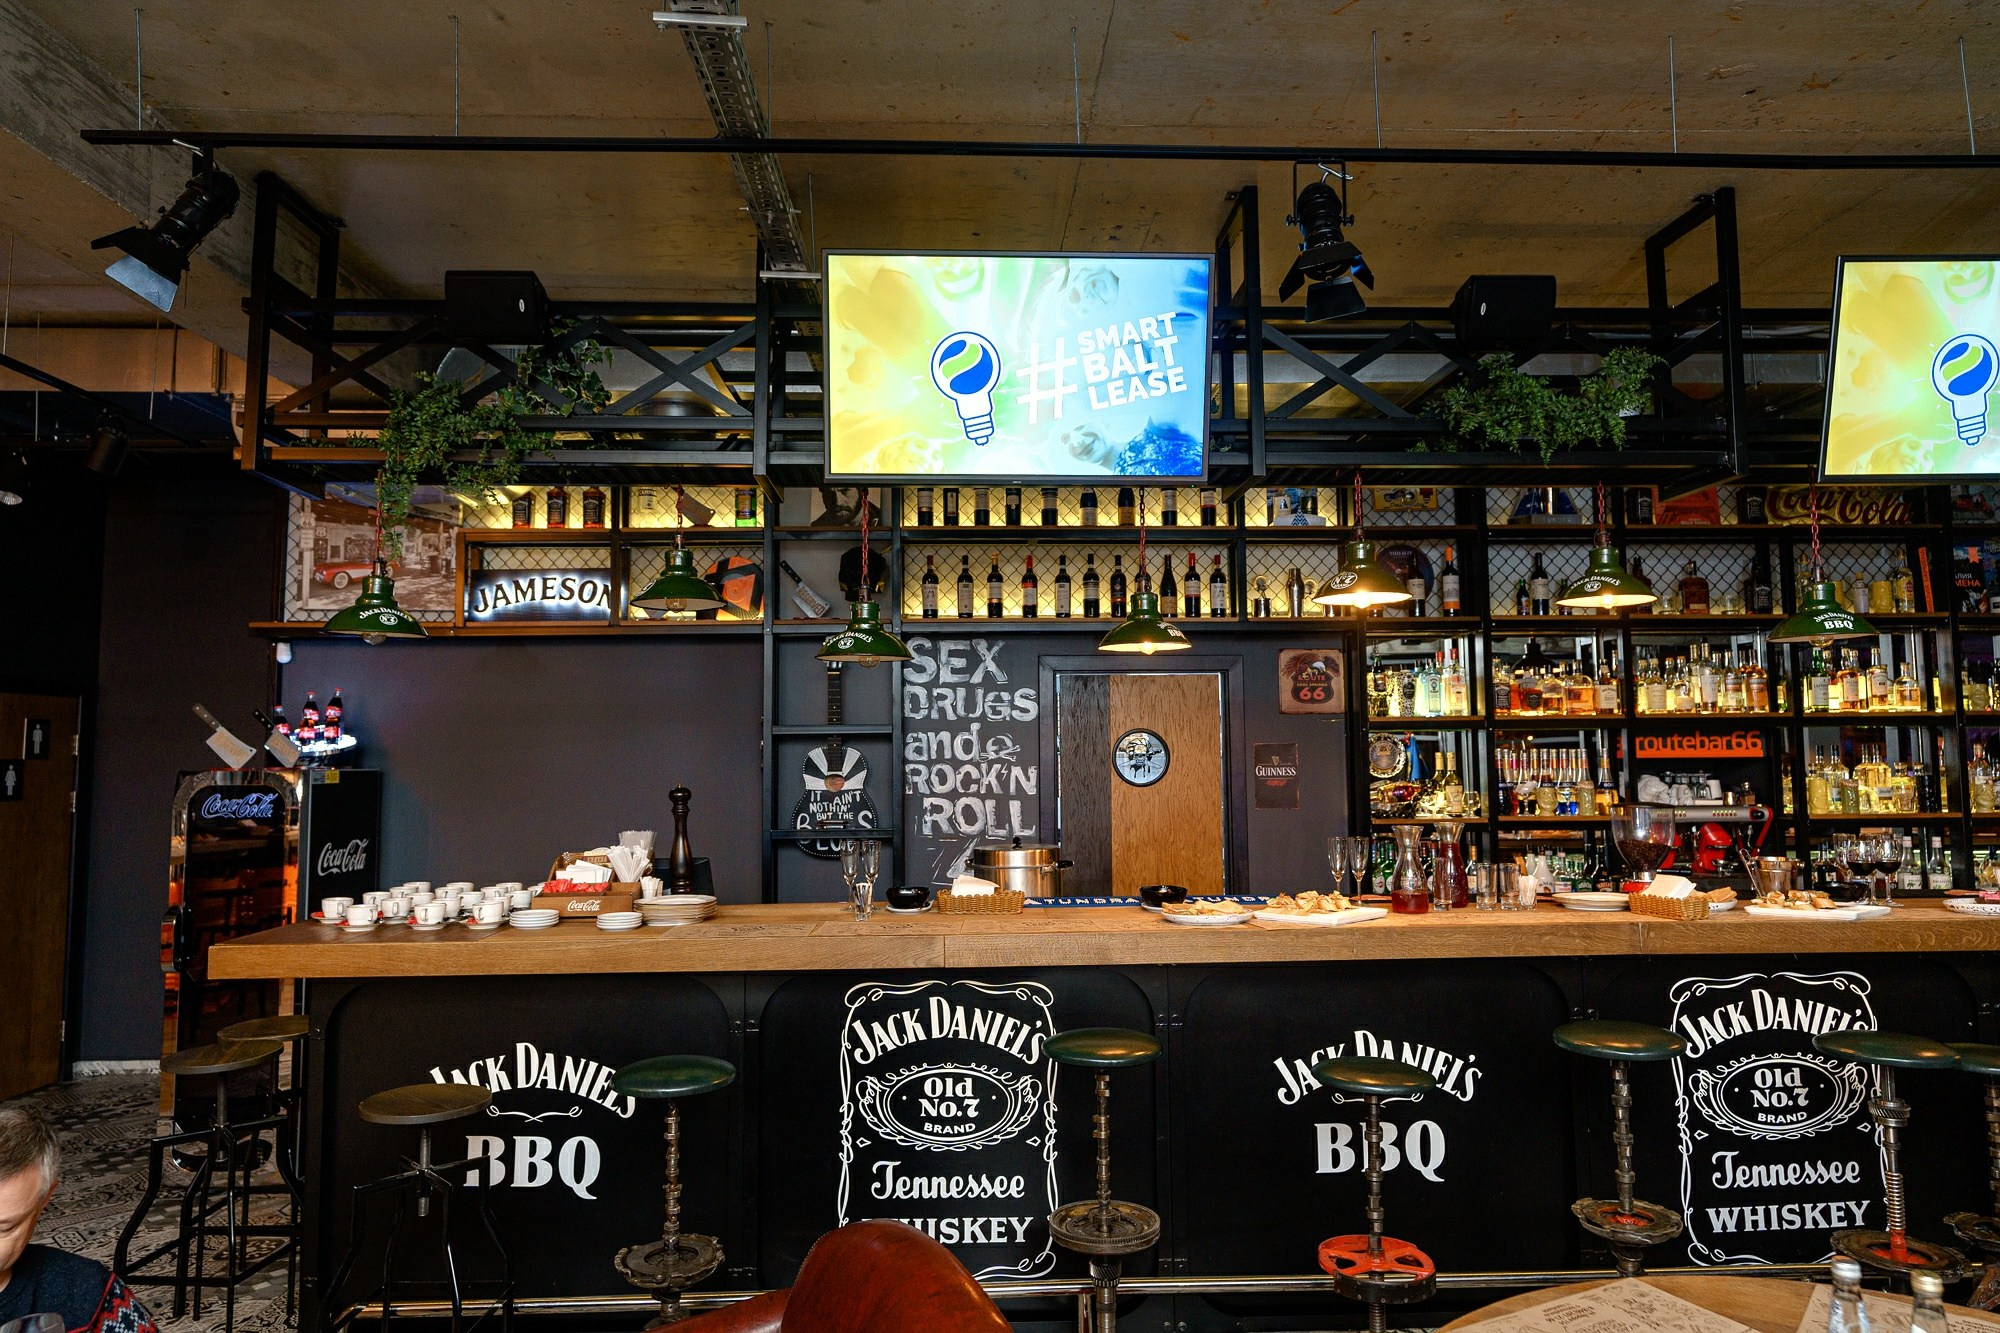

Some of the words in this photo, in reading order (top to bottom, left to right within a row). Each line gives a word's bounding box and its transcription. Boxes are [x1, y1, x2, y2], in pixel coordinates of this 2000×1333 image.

[1077, 312, 1177, 355] SMART
[1081, 336, 1179, 385] BALT
[1087, 367, 1188, 411] LEASE
[1823, 620, 1854, 630] BBQ
[903, 636, 1009, 685] SEX
[903, 683, 1039, 722] DRUGS
[1299, 686, 1326, 701] 66
[904, 722, 982, 763] and
[1635, 730, 1762, 752] routebar66
[1255, 765, 1297, 777] GUINNESS
[202, 793, 279, 819] Coca-Cola
[809, 801, 851, 814] NOTHIN'
[811, 790, 822, 802] IT
[833, 790, 861, 806] AIN'T
[816, 812, 833, 820] BUT
[838, 812, 854, 820] THE
[921, 796, 1036, 838] ROLL
[317, 838, 369, 877] Coca-Cola
[567, 900, 602, 912] Coca-Cola
[852, 1007, 928, 1065] JACK
[928, 996, 1048, 1065] DANIEL'S
[1679, 1001, 1753, 1059] JACK
[923, 1077, 975, 1098] Old
[1754, 1067, 1803, 1089] Old
[919, 1098, 979, 1118] No.7
[1750, 1087, 1809, 1109] No.7
[923, 1122, 976, 1135] BRAND
[1757, 1111, 1807, 1124] BRAND
[1313, 1119, 1446, 1183] BBQ
[463, 1135, 601, 1200] BBQ
[870, 1160, 1026, 1200] Tennessee
[1711, 1151, 1861, 1190] Tennessee
[1705, 1200, 1871, 1233] WHISKEY
